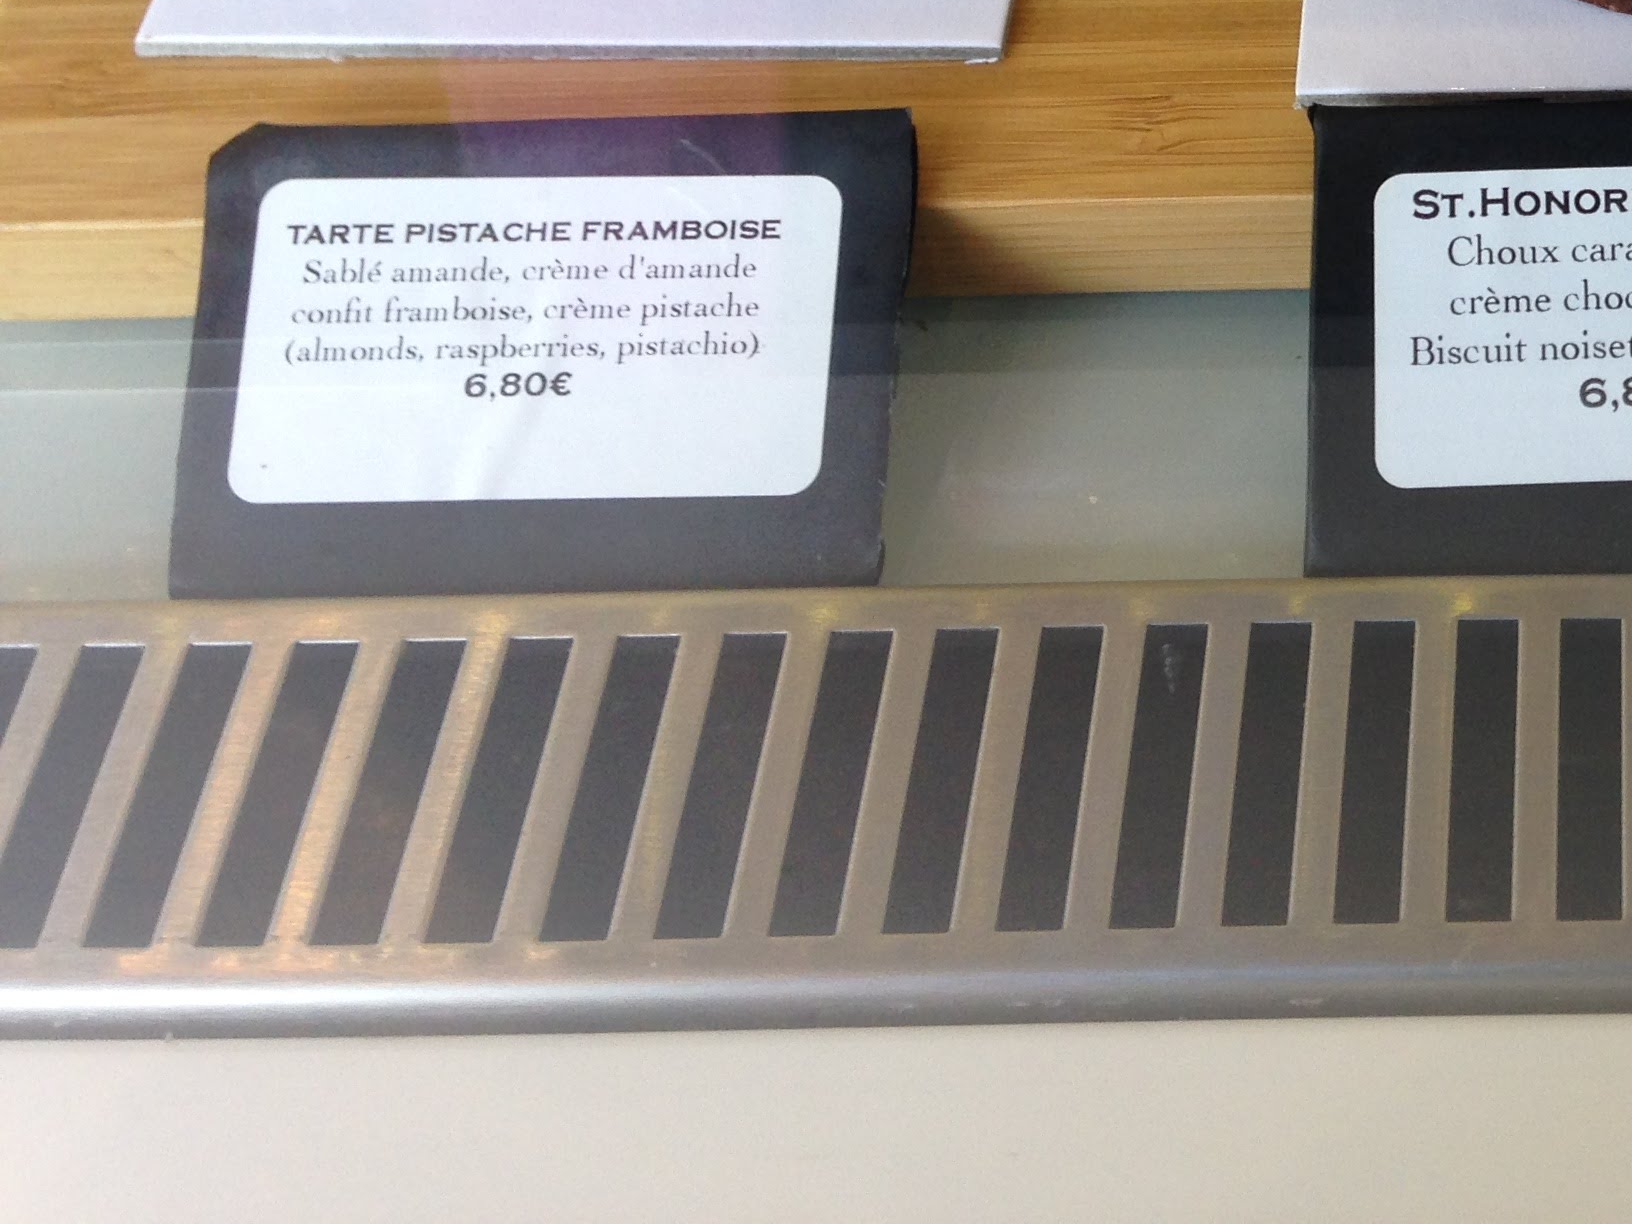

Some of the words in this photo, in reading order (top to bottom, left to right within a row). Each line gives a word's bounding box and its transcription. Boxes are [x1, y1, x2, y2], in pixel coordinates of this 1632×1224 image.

[287, 223, 395, 245] TARTE
[405, 221, 572, 244] PISTACHE
[582, 219, 781, 241] FRAMBOISE
[1448, 234, 1560, 266] Choux
[303, 258, 381, 284] Sablé
[391, 256, 509, 283] amande,
[523, 259, 608, 280] crème
[619, 253, 756, 279] d'amande
[292, 297, 372, 324] confit
[385, 296, 532, 323] framboise,
[544, 297, 630, 319] crème
[641, 292, 759, 326] pistache
[1450, 287, 1551, 315] crème
[285, 336, 424, 364] (almonds,
[436, 334, 605, 367] raspberries,
[617, 330, 760, 364] pistachio)
[1410, 332, 1527, 366] Biscuit
[464, 371, 573, 401] 6,80€
